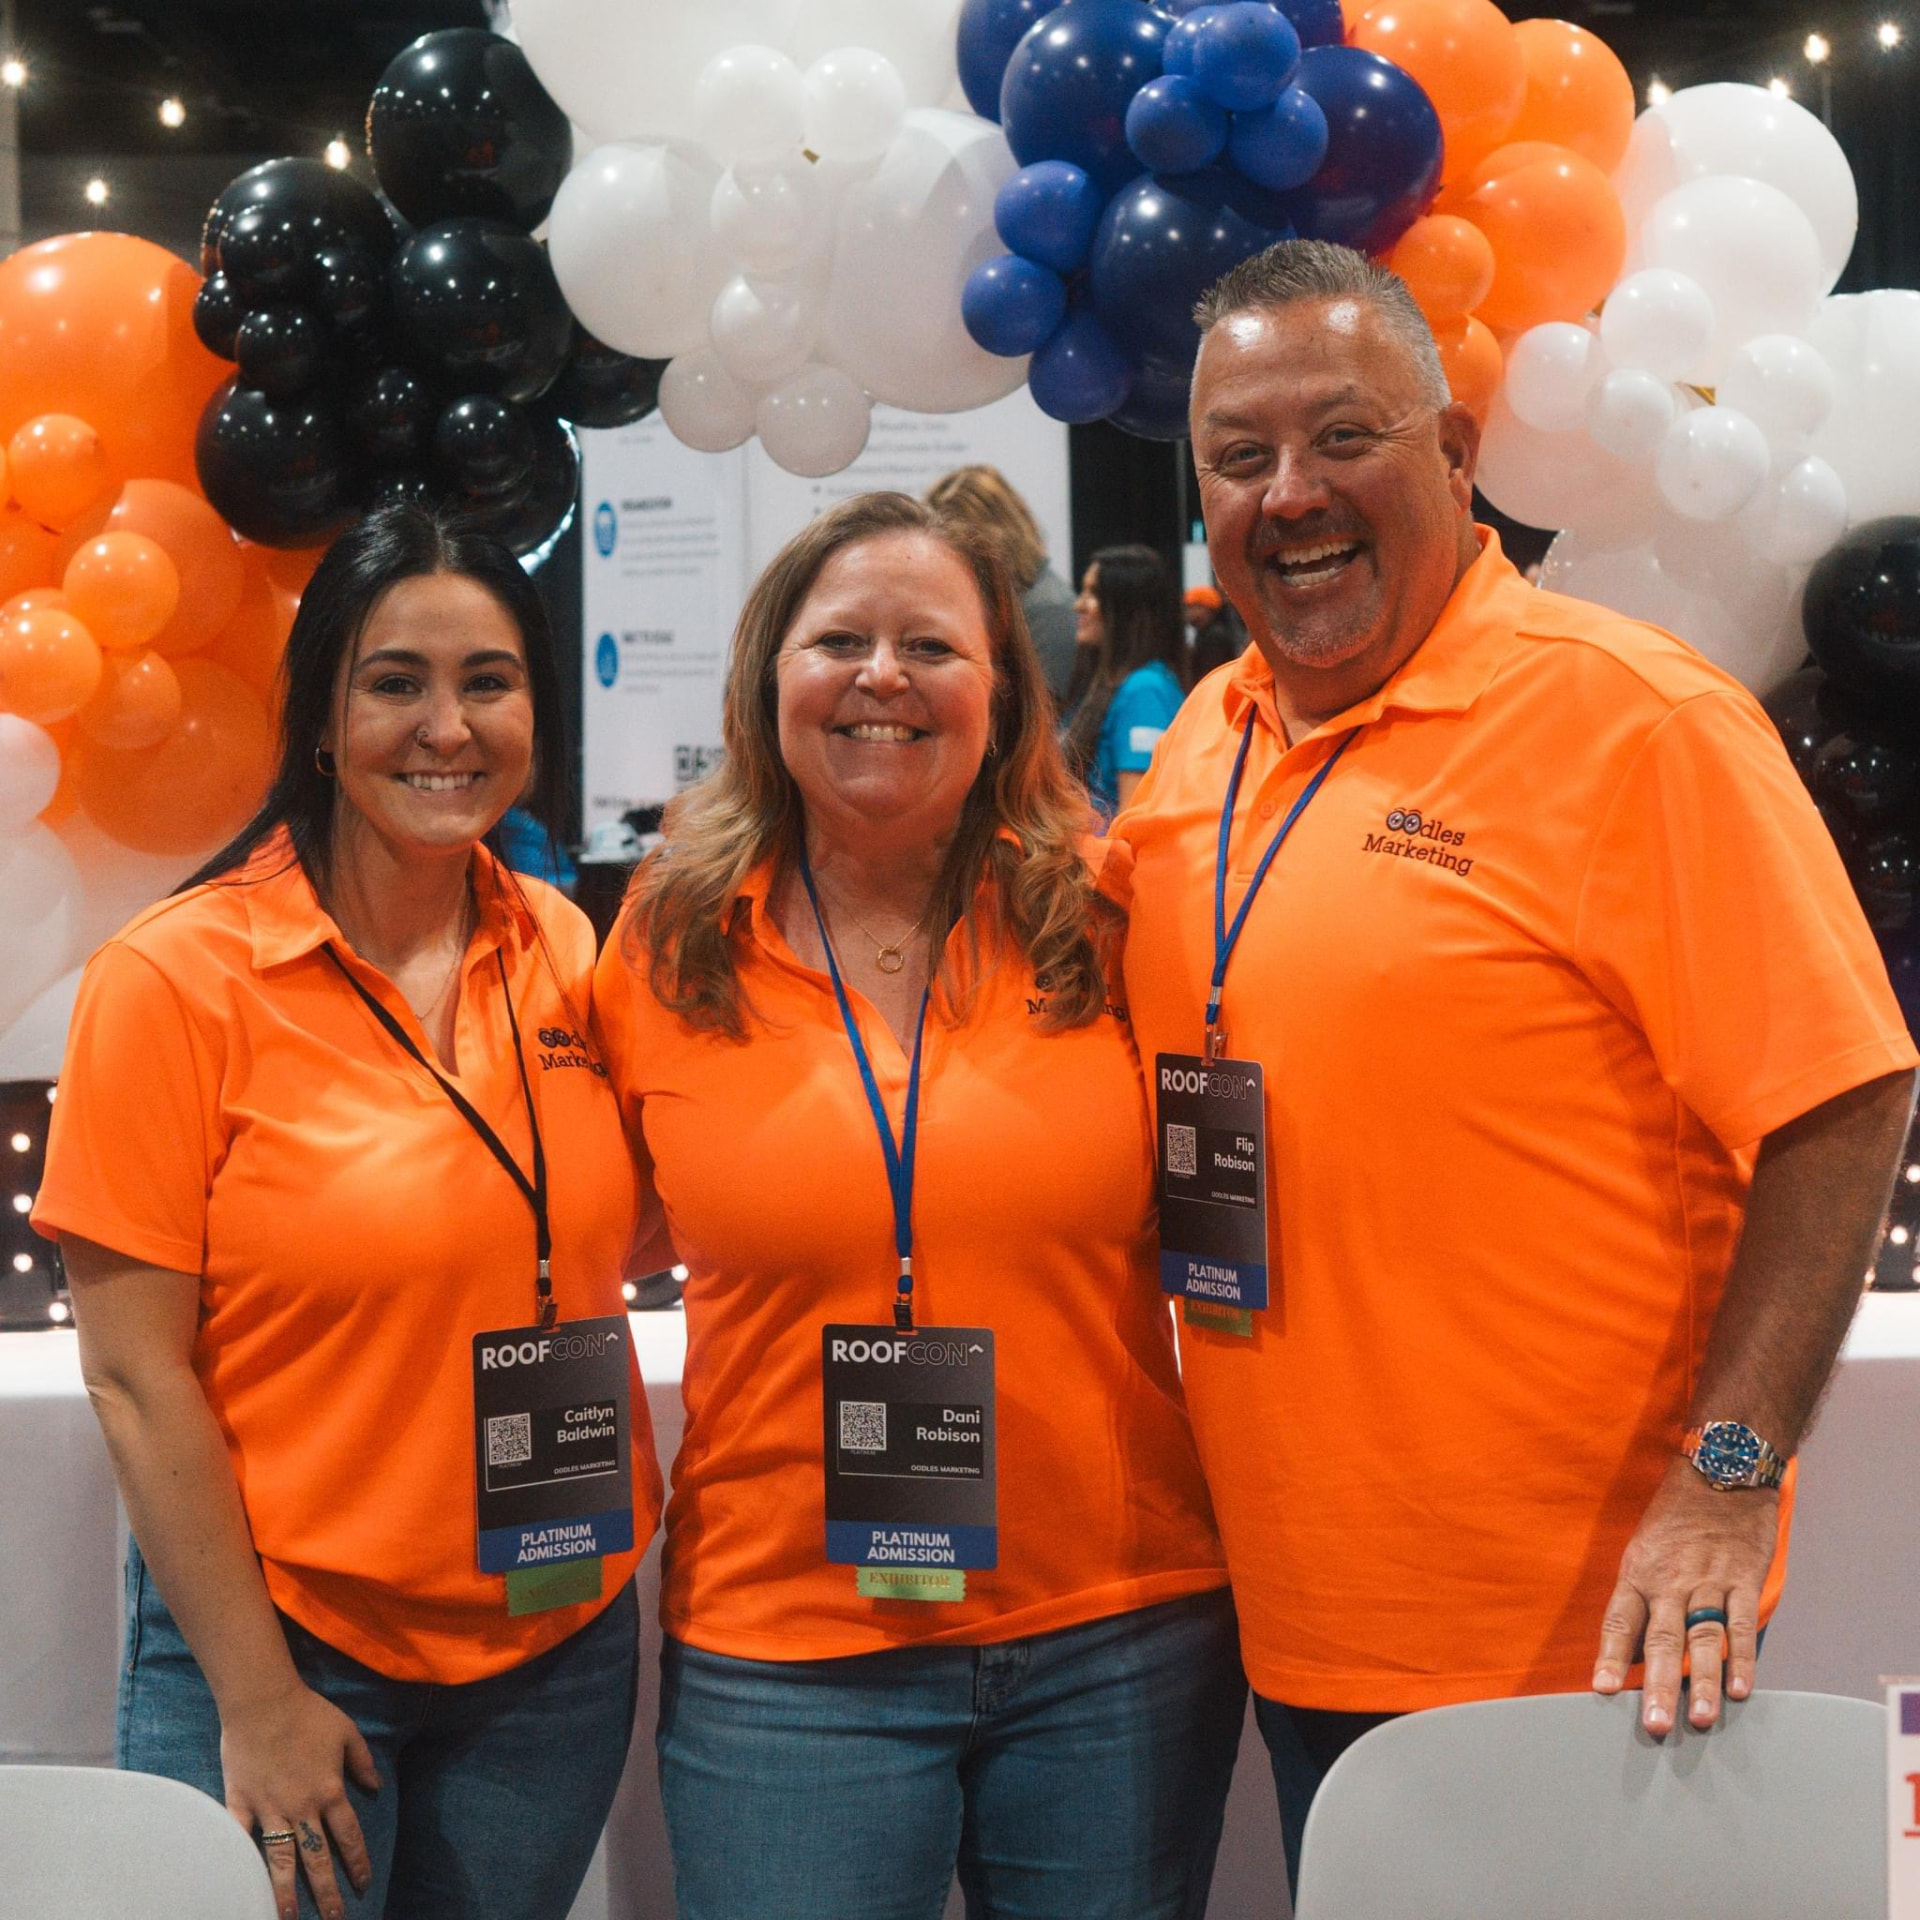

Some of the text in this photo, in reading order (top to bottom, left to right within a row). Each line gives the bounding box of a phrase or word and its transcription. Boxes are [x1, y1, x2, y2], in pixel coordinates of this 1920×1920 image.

[1362, 834, 1474, 877] Marketing
[1161, 1068, 1247, 1100] ROOFCON
[1236, 1136, 1255, 1154] Flip
[1214, 1153, 1255, 1172] Robison
[1188, 1263, 1238, 1284] PLATINUM
[1186, 1278, 1240, 1300] ADMISSION
[482, 1333, 606, 1370] ROOFCON
[832, 1339, 968, 1366] ROOFCON
[564, 1405, 614, 1425] Caitlyn
[943, 1409, 980, 1425] Dani
[557, 1424, 615, 1443] Baldwin
[916, 1427, 980, 1443] Robison
[580, 1460, 616, 1471] MARKETING
[911, 1465, 980, 1475] OODLES MARKETING
[521, 1523, 592, 1546] PLATINUM
[872, 1531, 950, 1547] PLATINUM
[517, 1538, 597, 1563] ADMISSION
[867, 1547, 955, 1563] ADMISSION
[869, 1571, 951, 1586] EXHIBITOR
